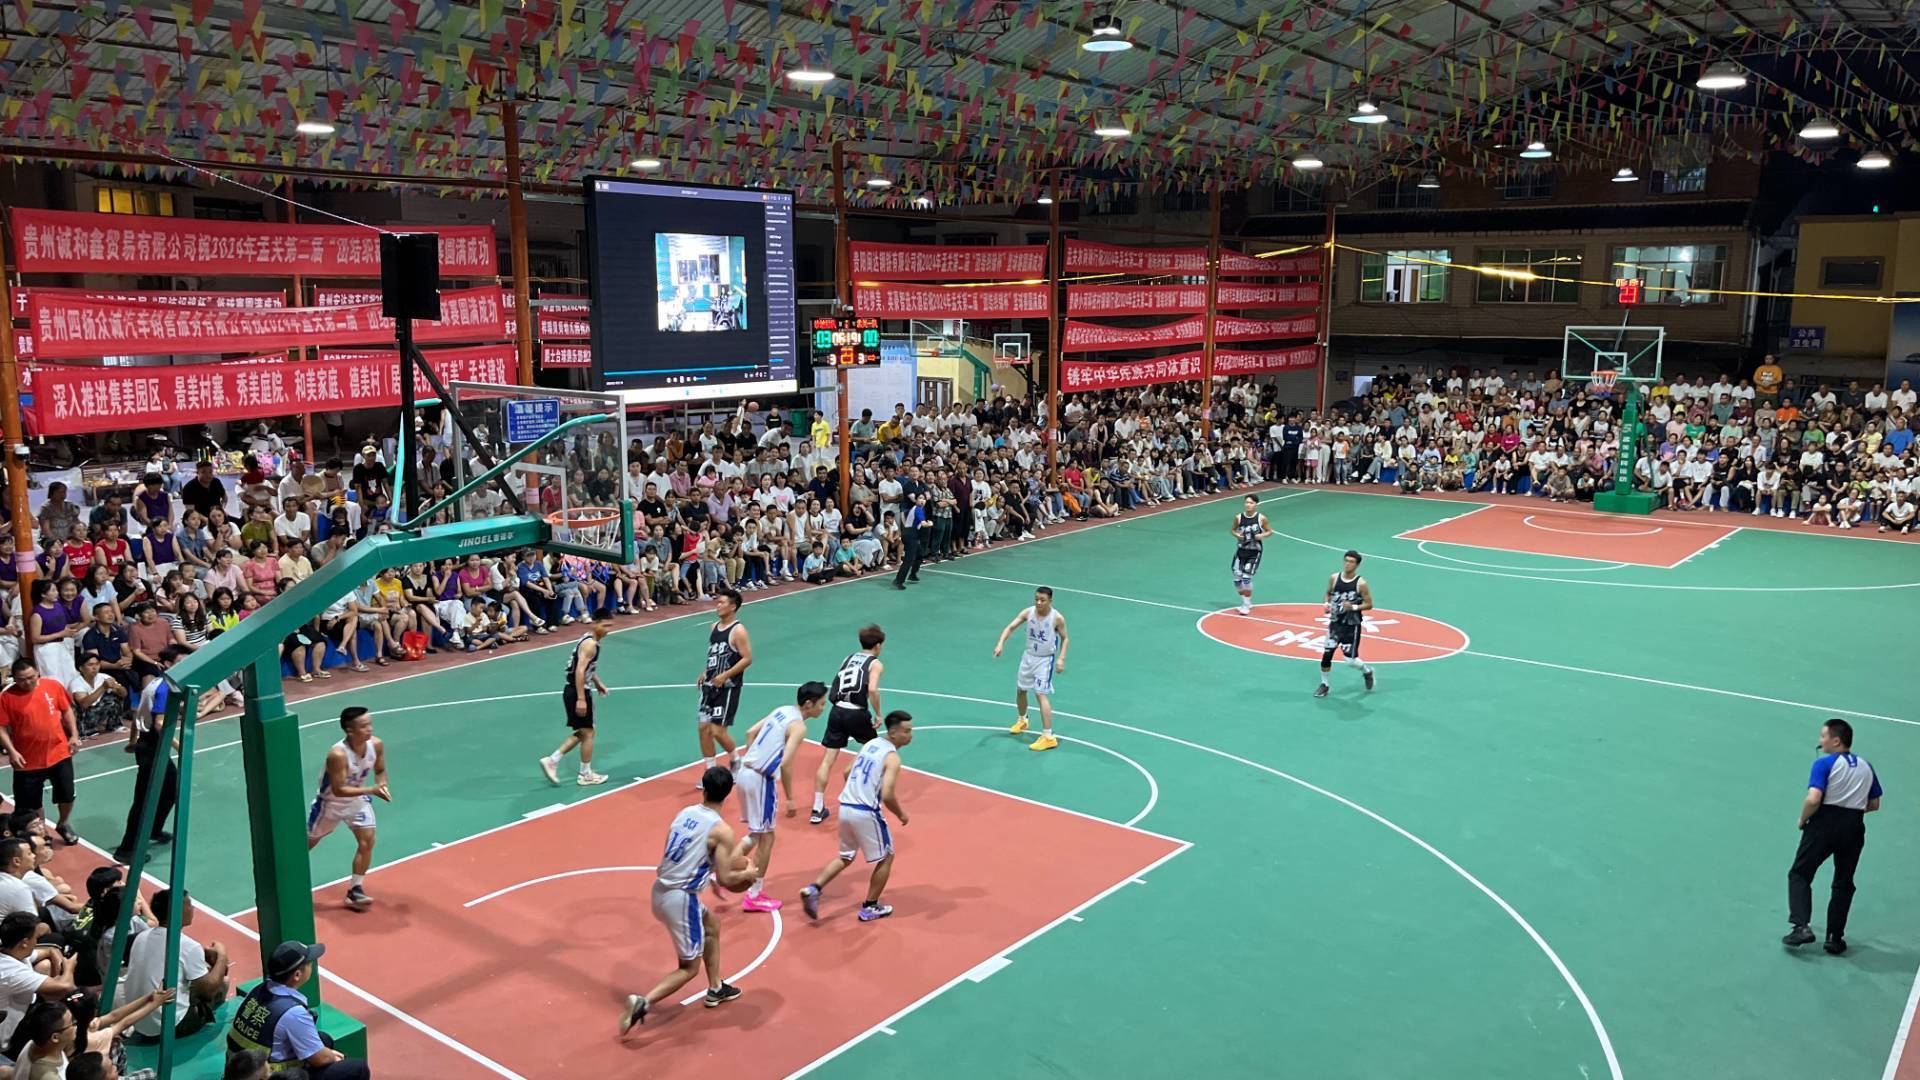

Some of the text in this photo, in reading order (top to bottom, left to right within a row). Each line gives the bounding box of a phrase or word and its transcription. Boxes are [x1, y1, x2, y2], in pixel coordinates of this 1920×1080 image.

[1792, 339, 1821, 348] 卫生间
[1798, 329, 1816, 338] 公共
[1066, 356, 1201, 387] 铸牢中华民族共同体意识
[850, 755, 874, 785] 24
[242, 997, 271, 1027] 警察
[234, 1018, 261, 1040] POLICE
